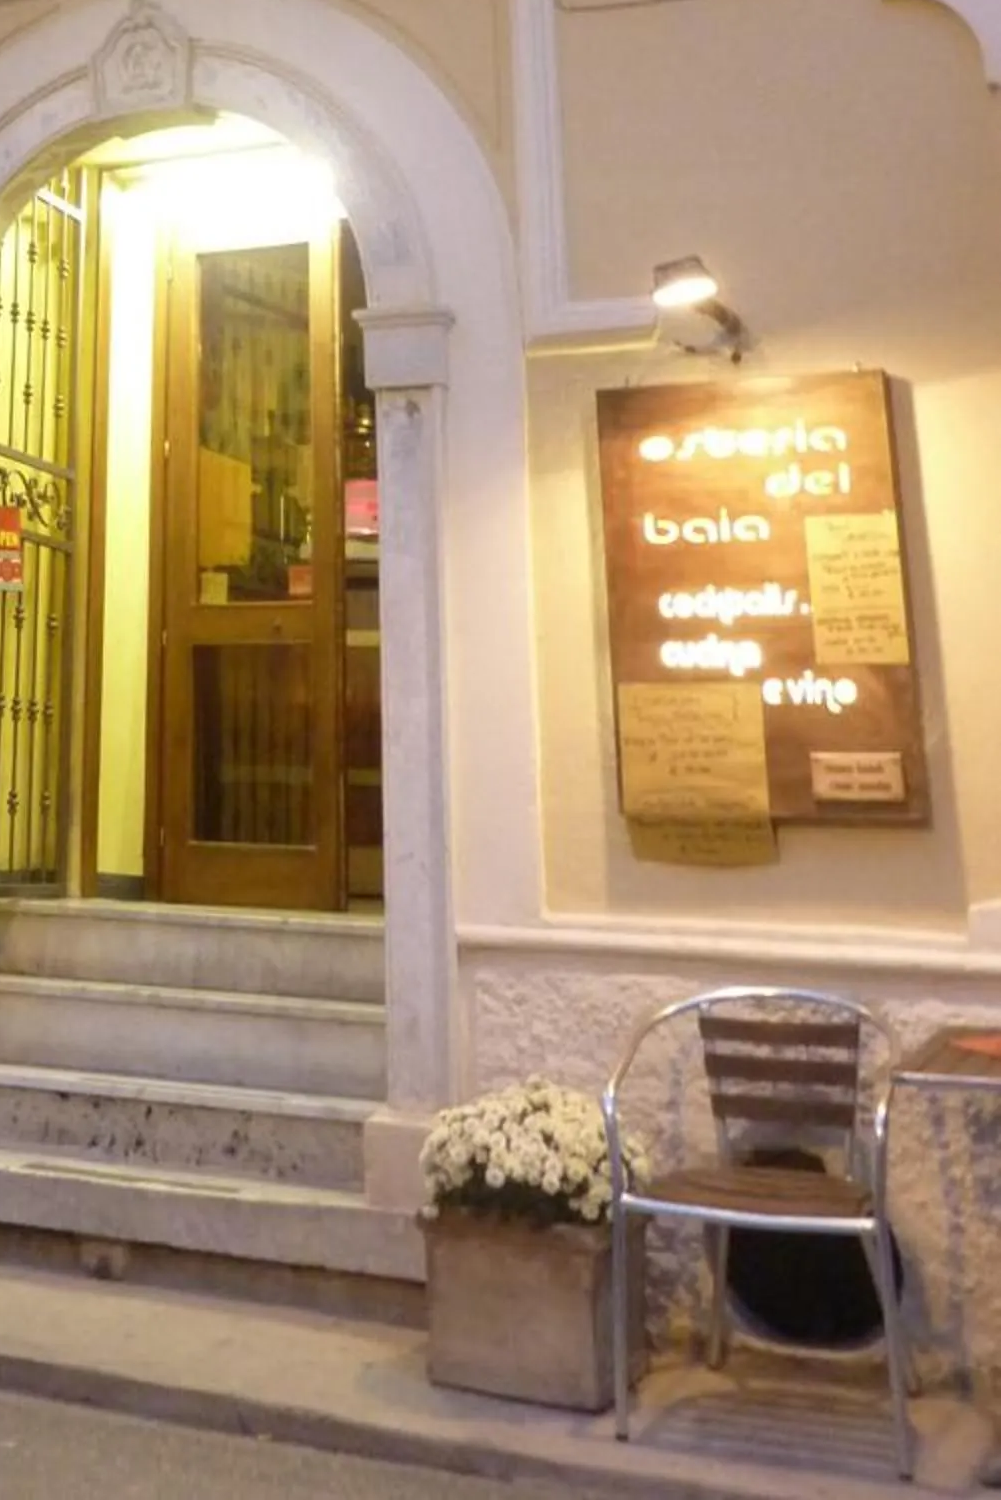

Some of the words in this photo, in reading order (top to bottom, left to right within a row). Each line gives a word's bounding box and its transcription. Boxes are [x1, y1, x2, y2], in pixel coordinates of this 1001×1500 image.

[639, 417, 847, 462] osteria
[764, 461, 850, 498] del
[643, 506, 770, 544] baia
[762, 678, 783, 704] e
[786, 669, 857, 714] vino
